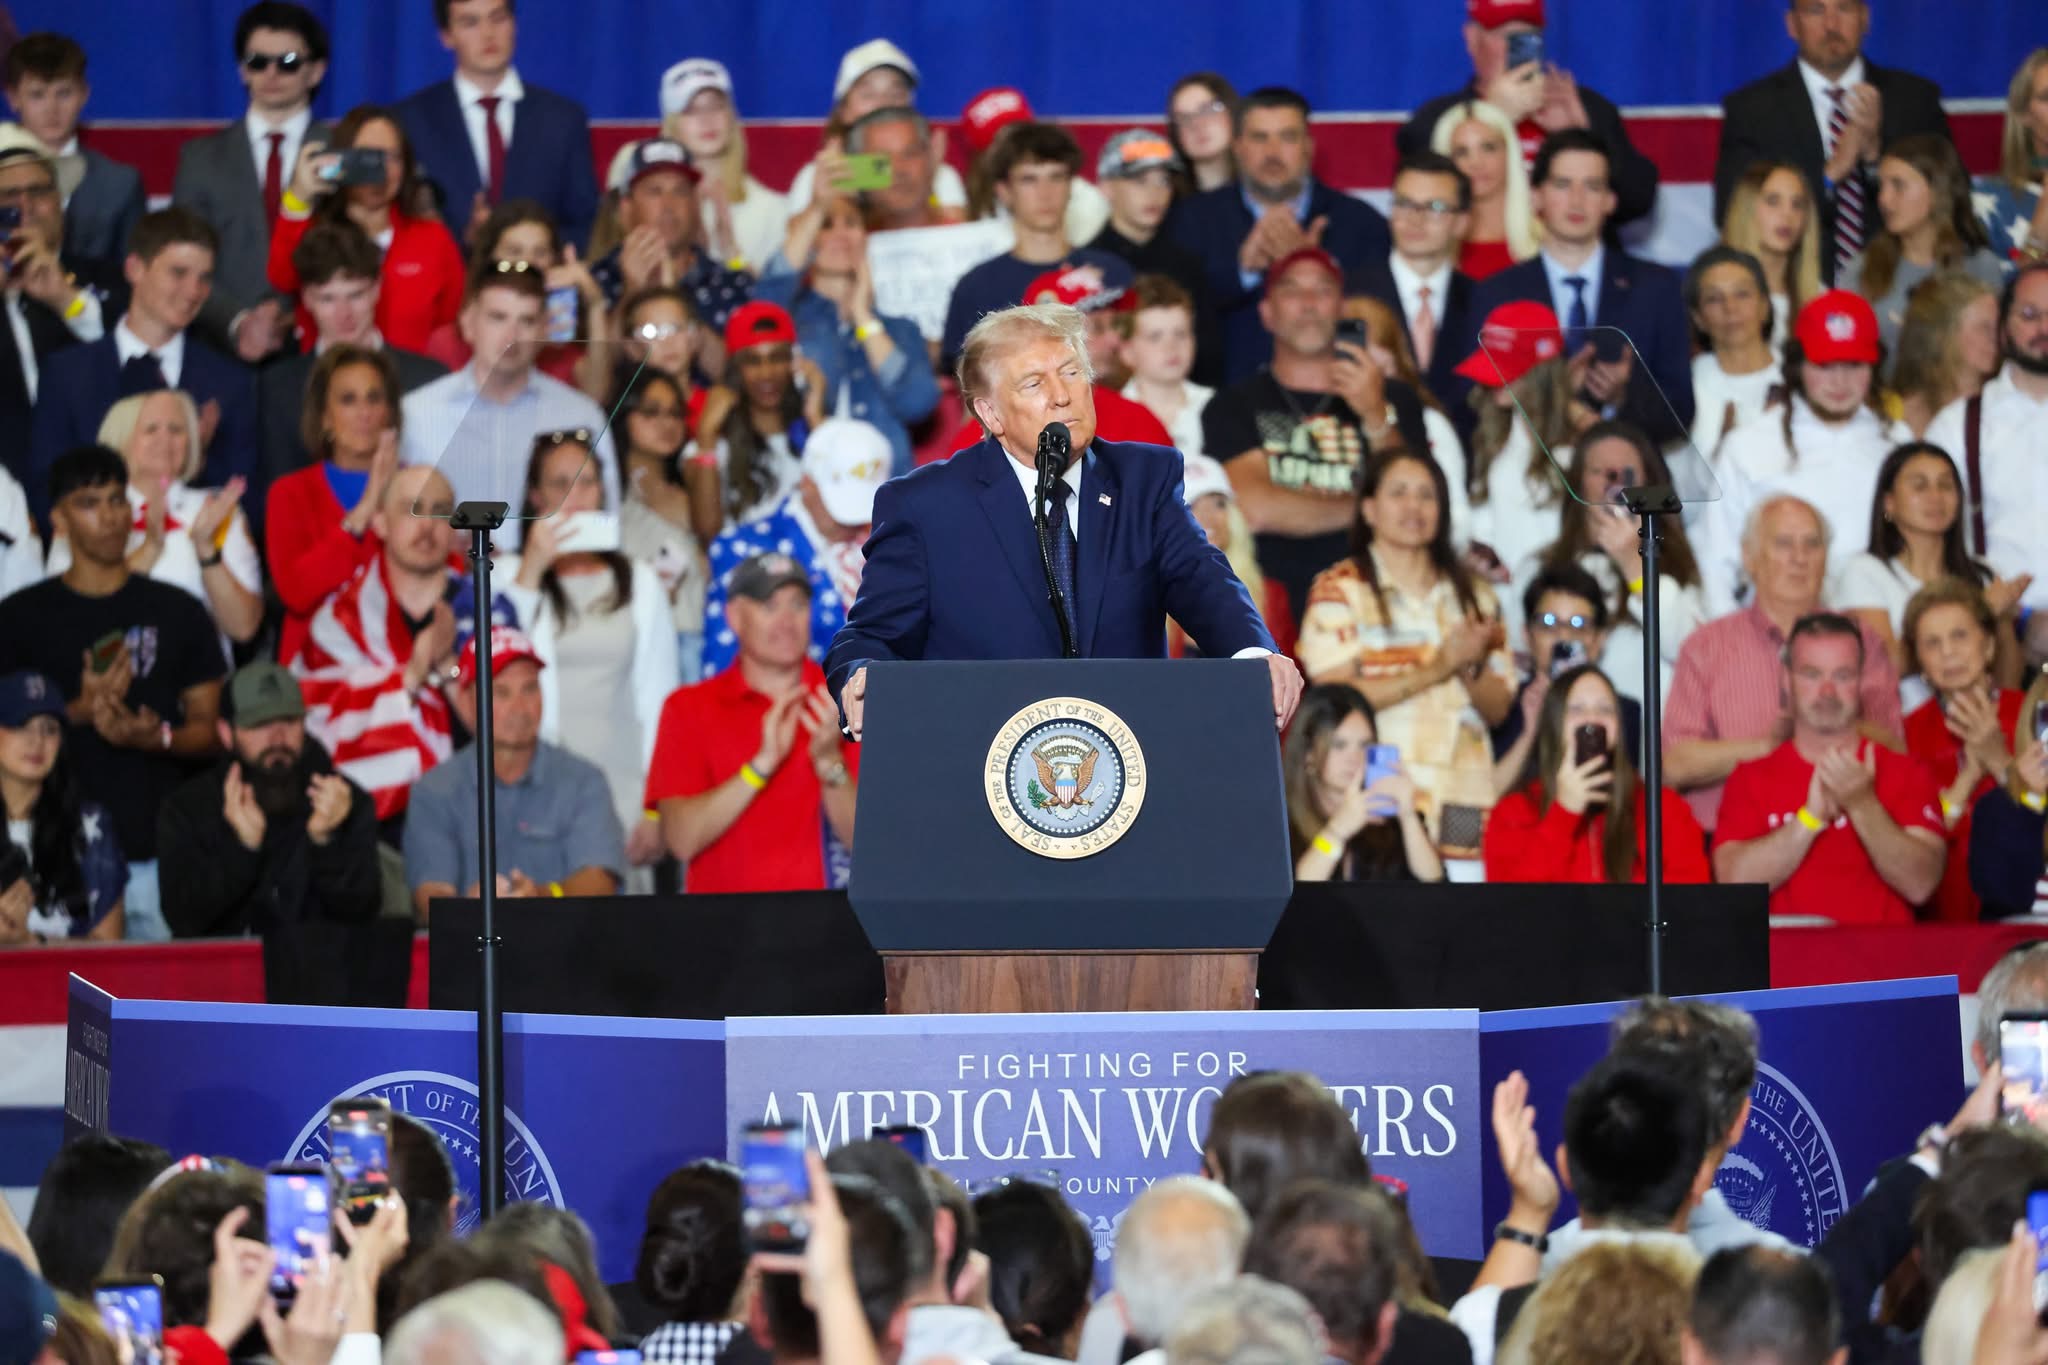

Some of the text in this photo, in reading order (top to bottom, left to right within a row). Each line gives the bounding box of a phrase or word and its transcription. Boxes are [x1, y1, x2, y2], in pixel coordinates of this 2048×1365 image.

[990, 703, 1141, 851] SEAL OF THE PRESIDENT OF THE UNITED STATES
[958, 1051, 1247, 1080] FIGHTING FOR
[425, 1090, 454, 1113] OF
[1121, 1084, 1457, 1160] WOERS
[1754, 1081, 1842, 1232] THE UNITE
[1056, 1176, 1157, 1195] OUNTY
